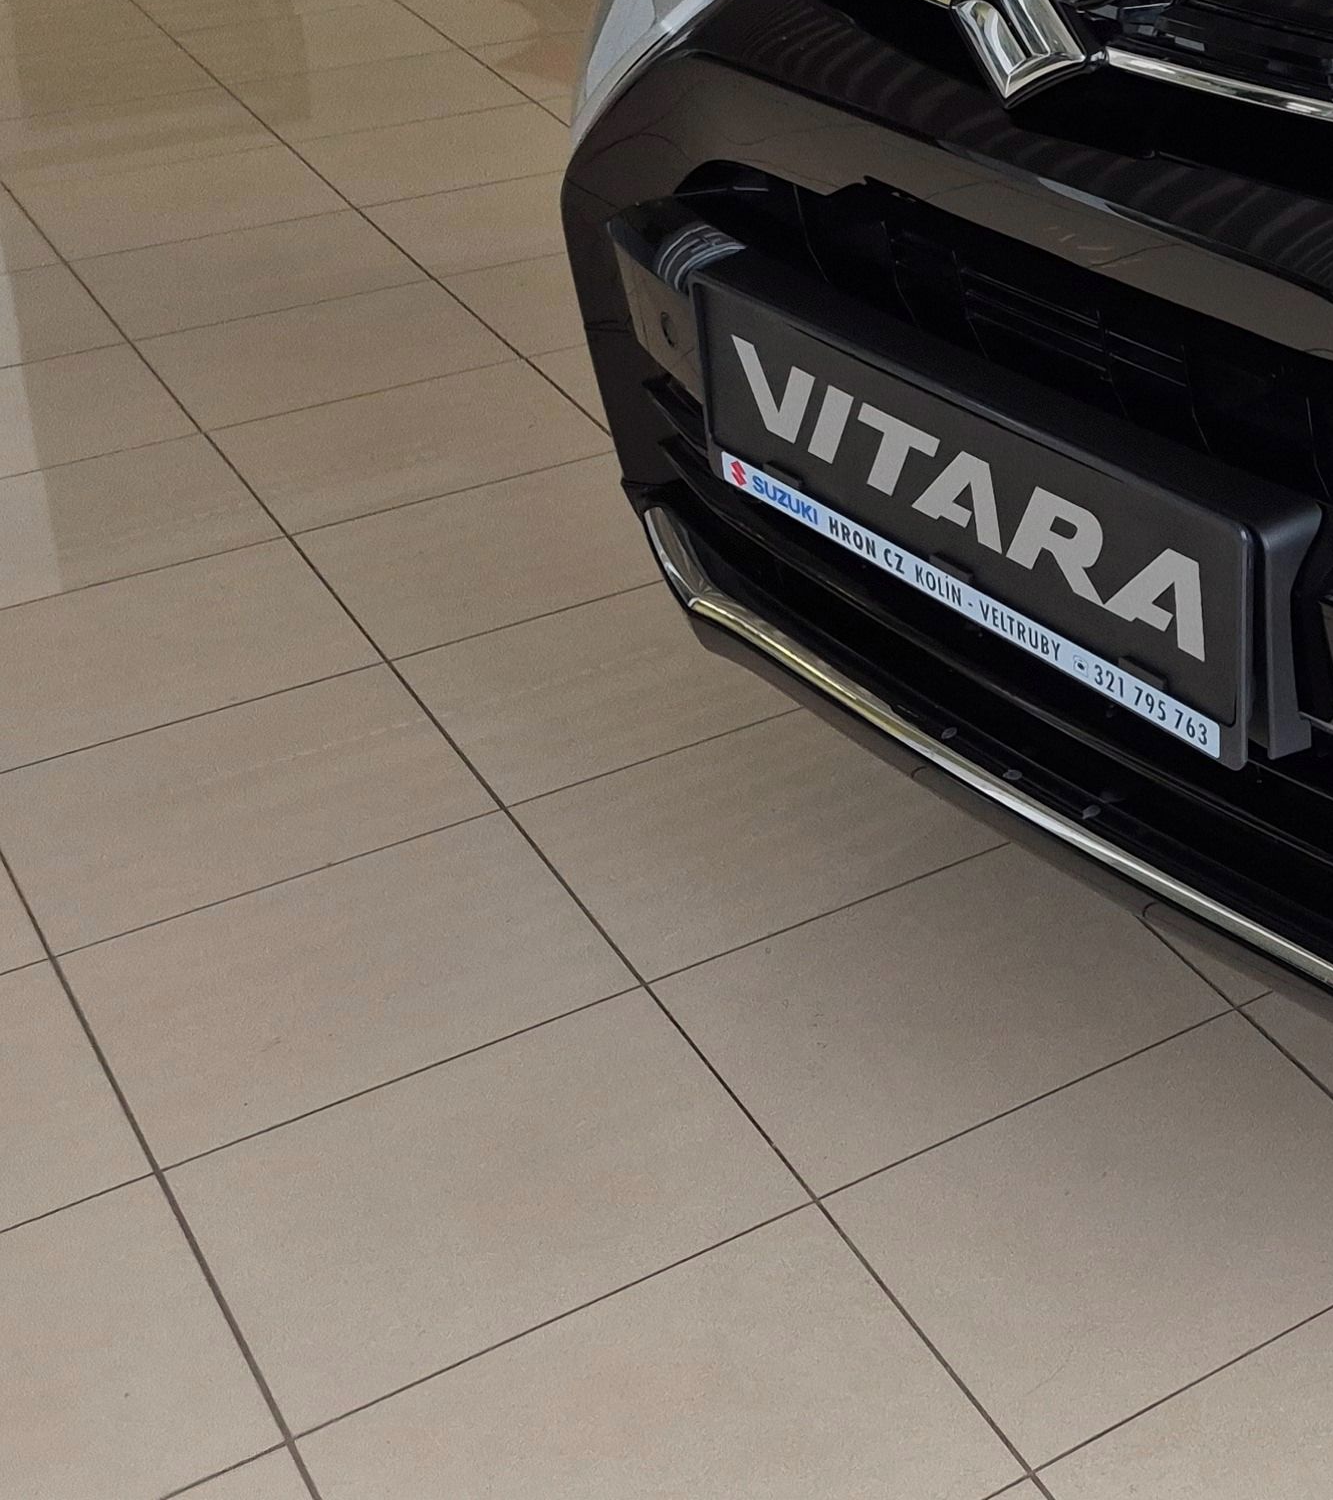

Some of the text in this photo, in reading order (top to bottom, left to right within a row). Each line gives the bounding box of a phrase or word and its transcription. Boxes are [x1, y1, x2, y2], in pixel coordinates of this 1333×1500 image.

[730, 334, 1207, 663] VITARA
[751, 475, 819, 526] SUZUKI
[828, 515, 877, 559] HRON
[883, 548, 906, 575] CZ
[914, 563, 963, 608] KOLÍN
[979, 599, 1062, 662] VELTRUBY
[1094, 664, 1124, 698] 321
[1133, 685, 1167, 722] 795
[1174, 708, 1209, 746] 763
